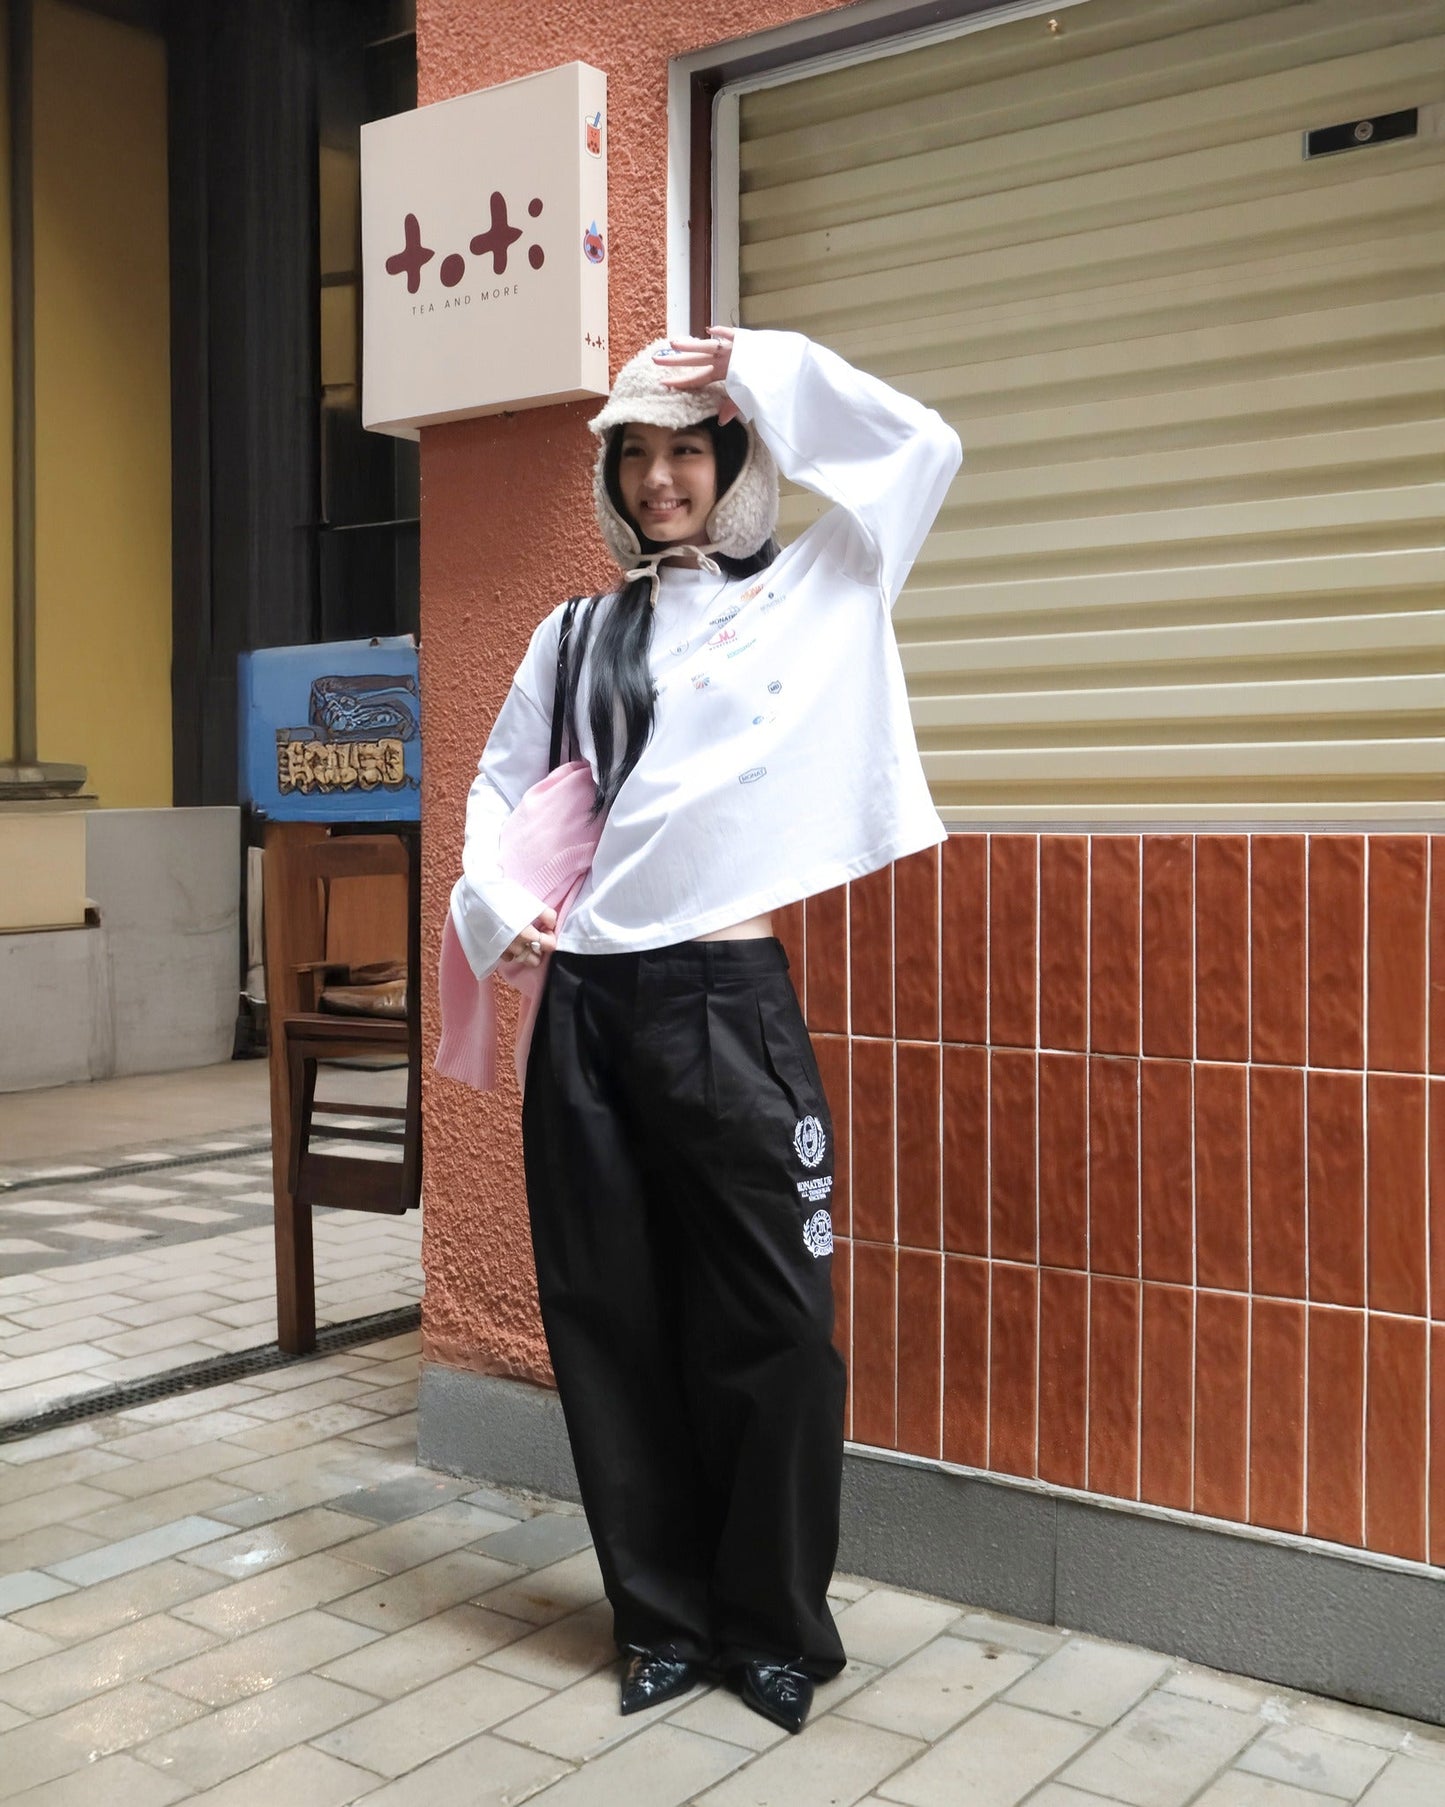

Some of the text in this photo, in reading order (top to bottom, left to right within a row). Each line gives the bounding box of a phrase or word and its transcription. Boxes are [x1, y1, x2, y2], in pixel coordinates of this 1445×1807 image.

[411, 284, 520, 316] TEA AND MORE
